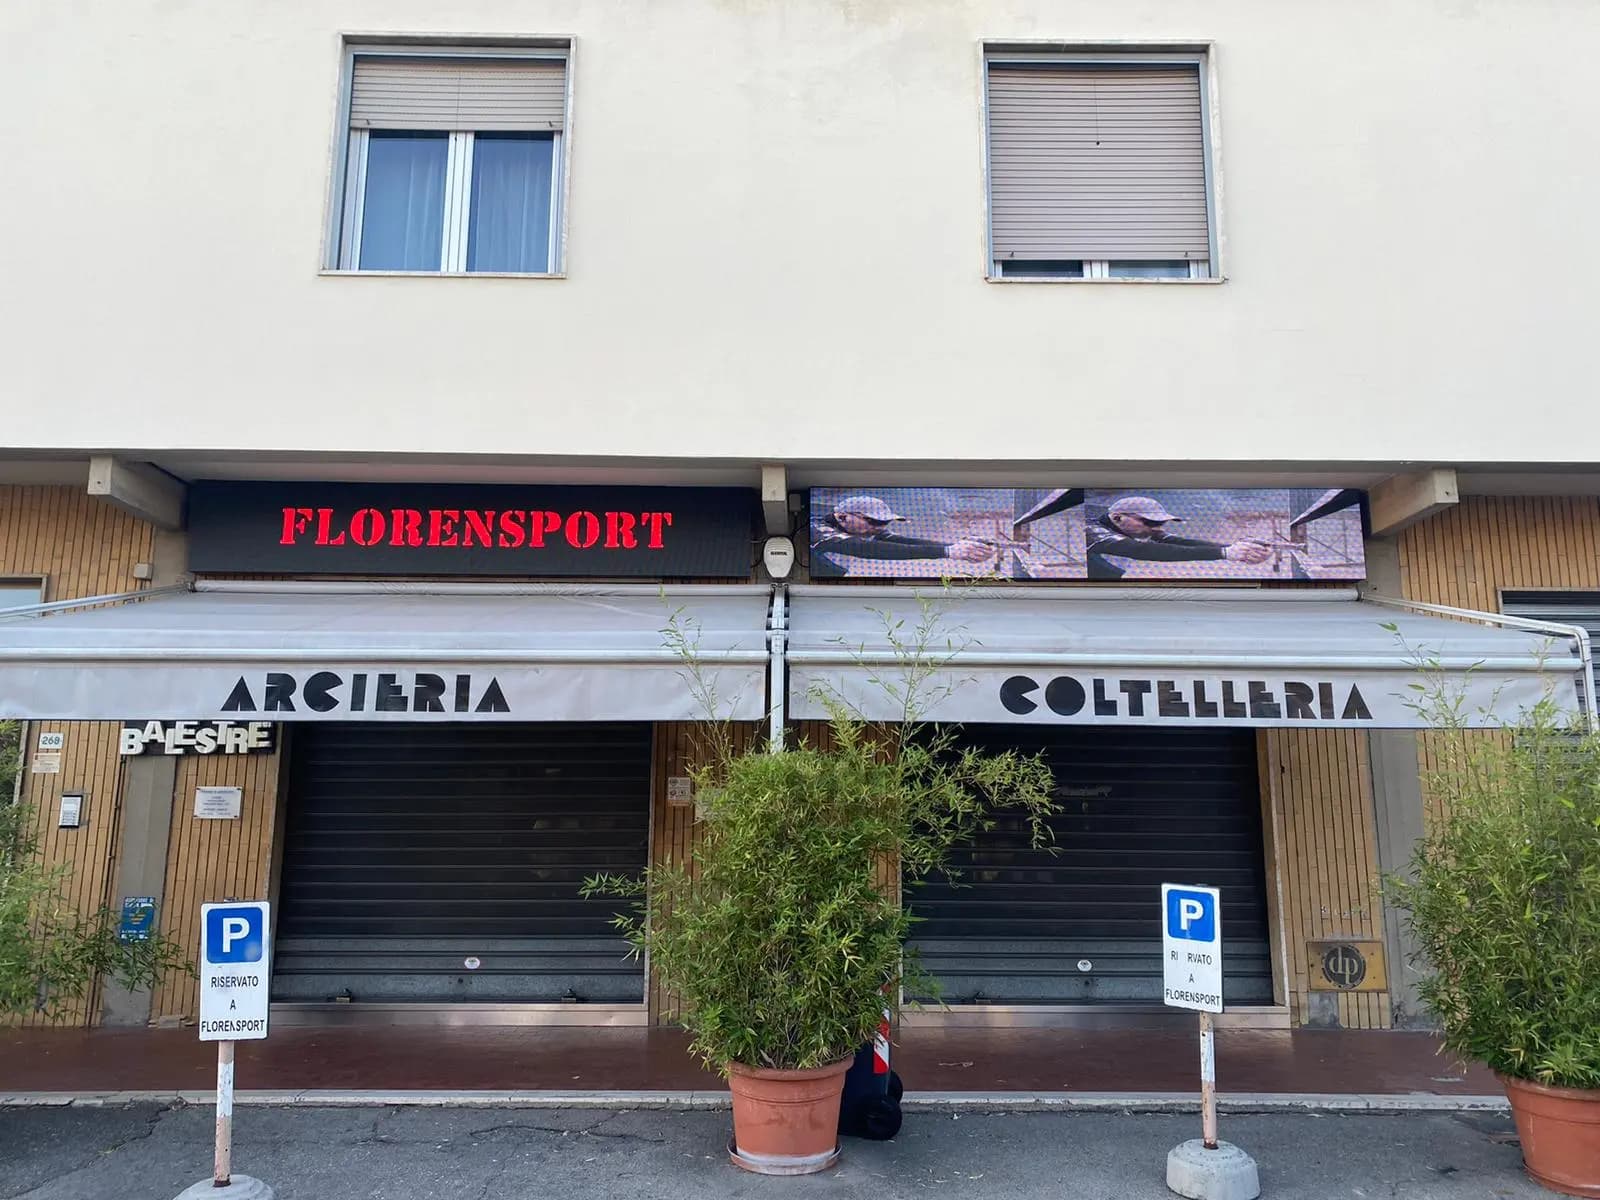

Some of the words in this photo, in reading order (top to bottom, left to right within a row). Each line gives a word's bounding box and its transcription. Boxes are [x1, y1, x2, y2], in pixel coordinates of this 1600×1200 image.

[279, 507, 673, 549] FLORENSPORT
[219, 671, 511, 713] ARCIERIA
[999, 675, 1373, 720] COLTELLERIA
[41, 736, 61, 745] 268
[119, 720, 272, 755] BALESTRE
[1179, 898, 1204, 931] P
[222, 917, 250, 953] P
[210, 975, 259, 988] RISERVATO
[1188, 973, 1195, 983] A
[229, 999, 237, 1010] A
[1165, 988, 1221, 1006] FLORENSPORT
[201, 1019, 265, 1032] FLORENSPORT
